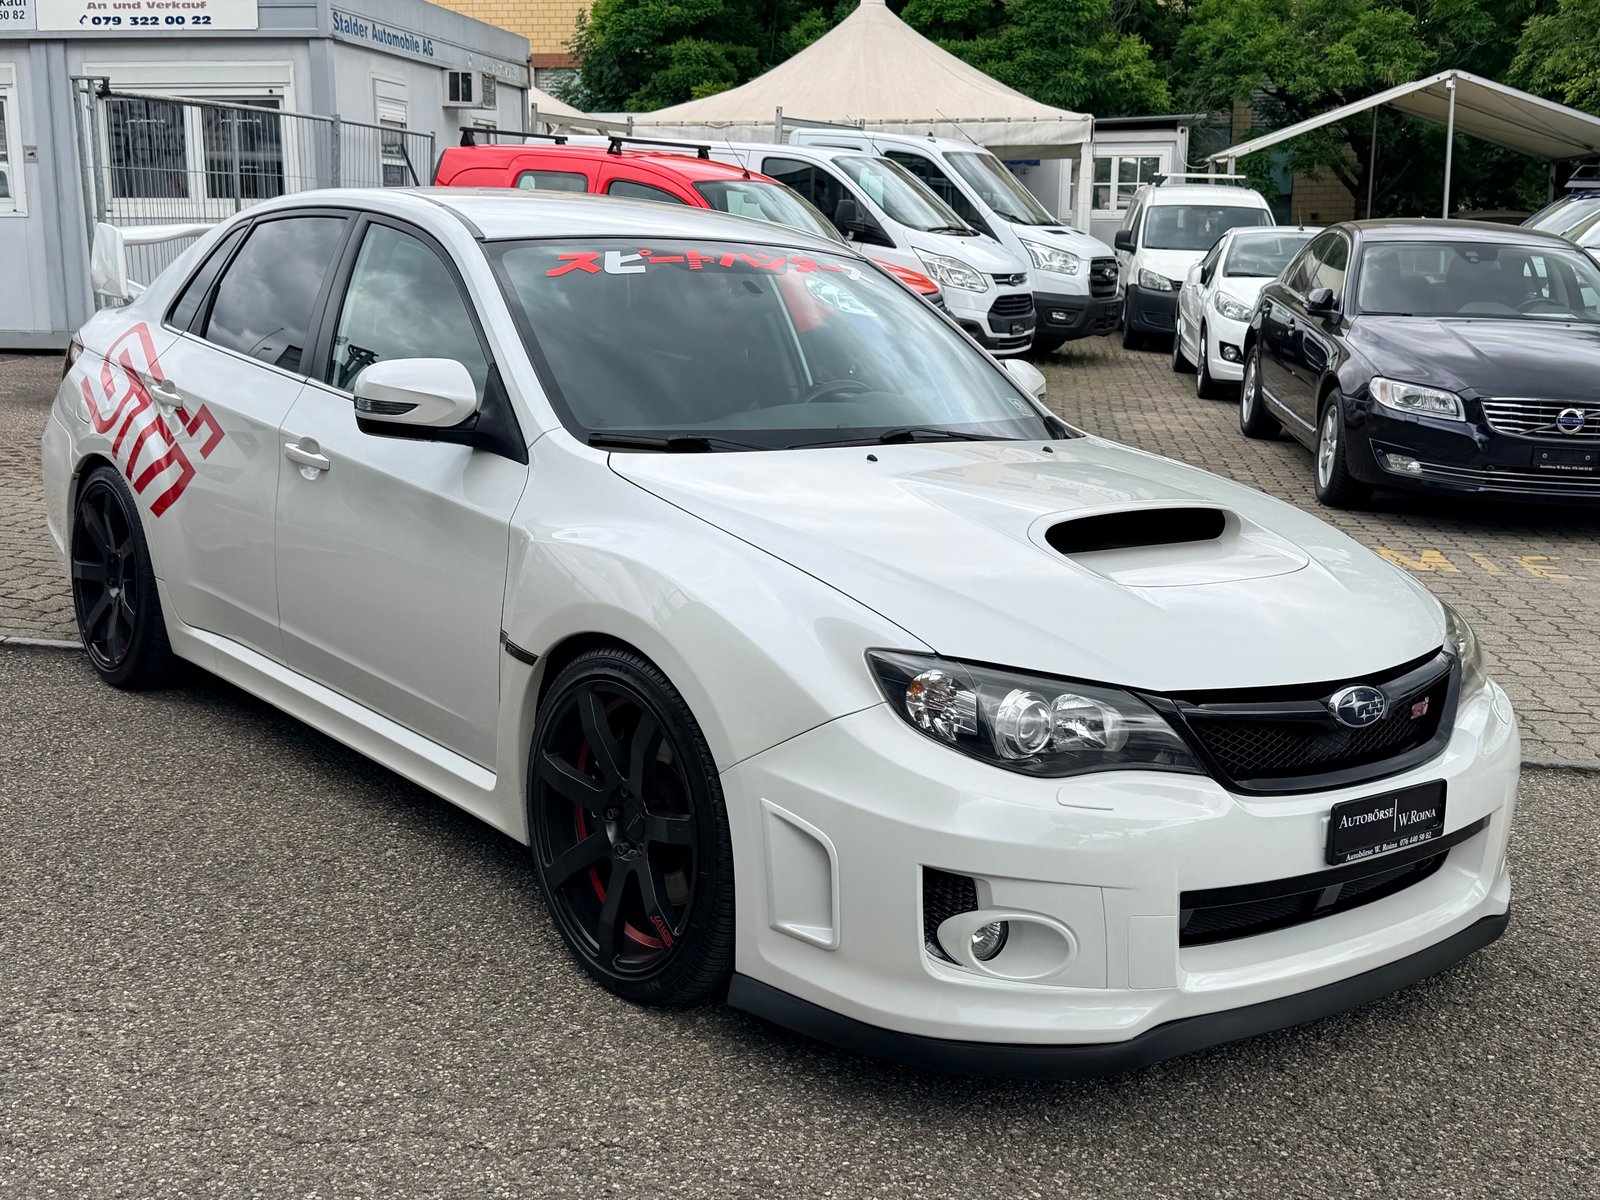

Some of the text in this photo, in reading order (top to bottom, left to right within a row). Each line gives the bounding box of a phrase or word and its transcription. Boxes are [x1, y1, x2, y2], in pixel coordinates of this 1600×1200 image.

[86, 1, 208, 10] An und Verkauf
[12, 10, 25, 20] 82
[91, 15, 212, 26] 079 322 00 22
[332, 11, 434, 57] Stalder Automobile AG
